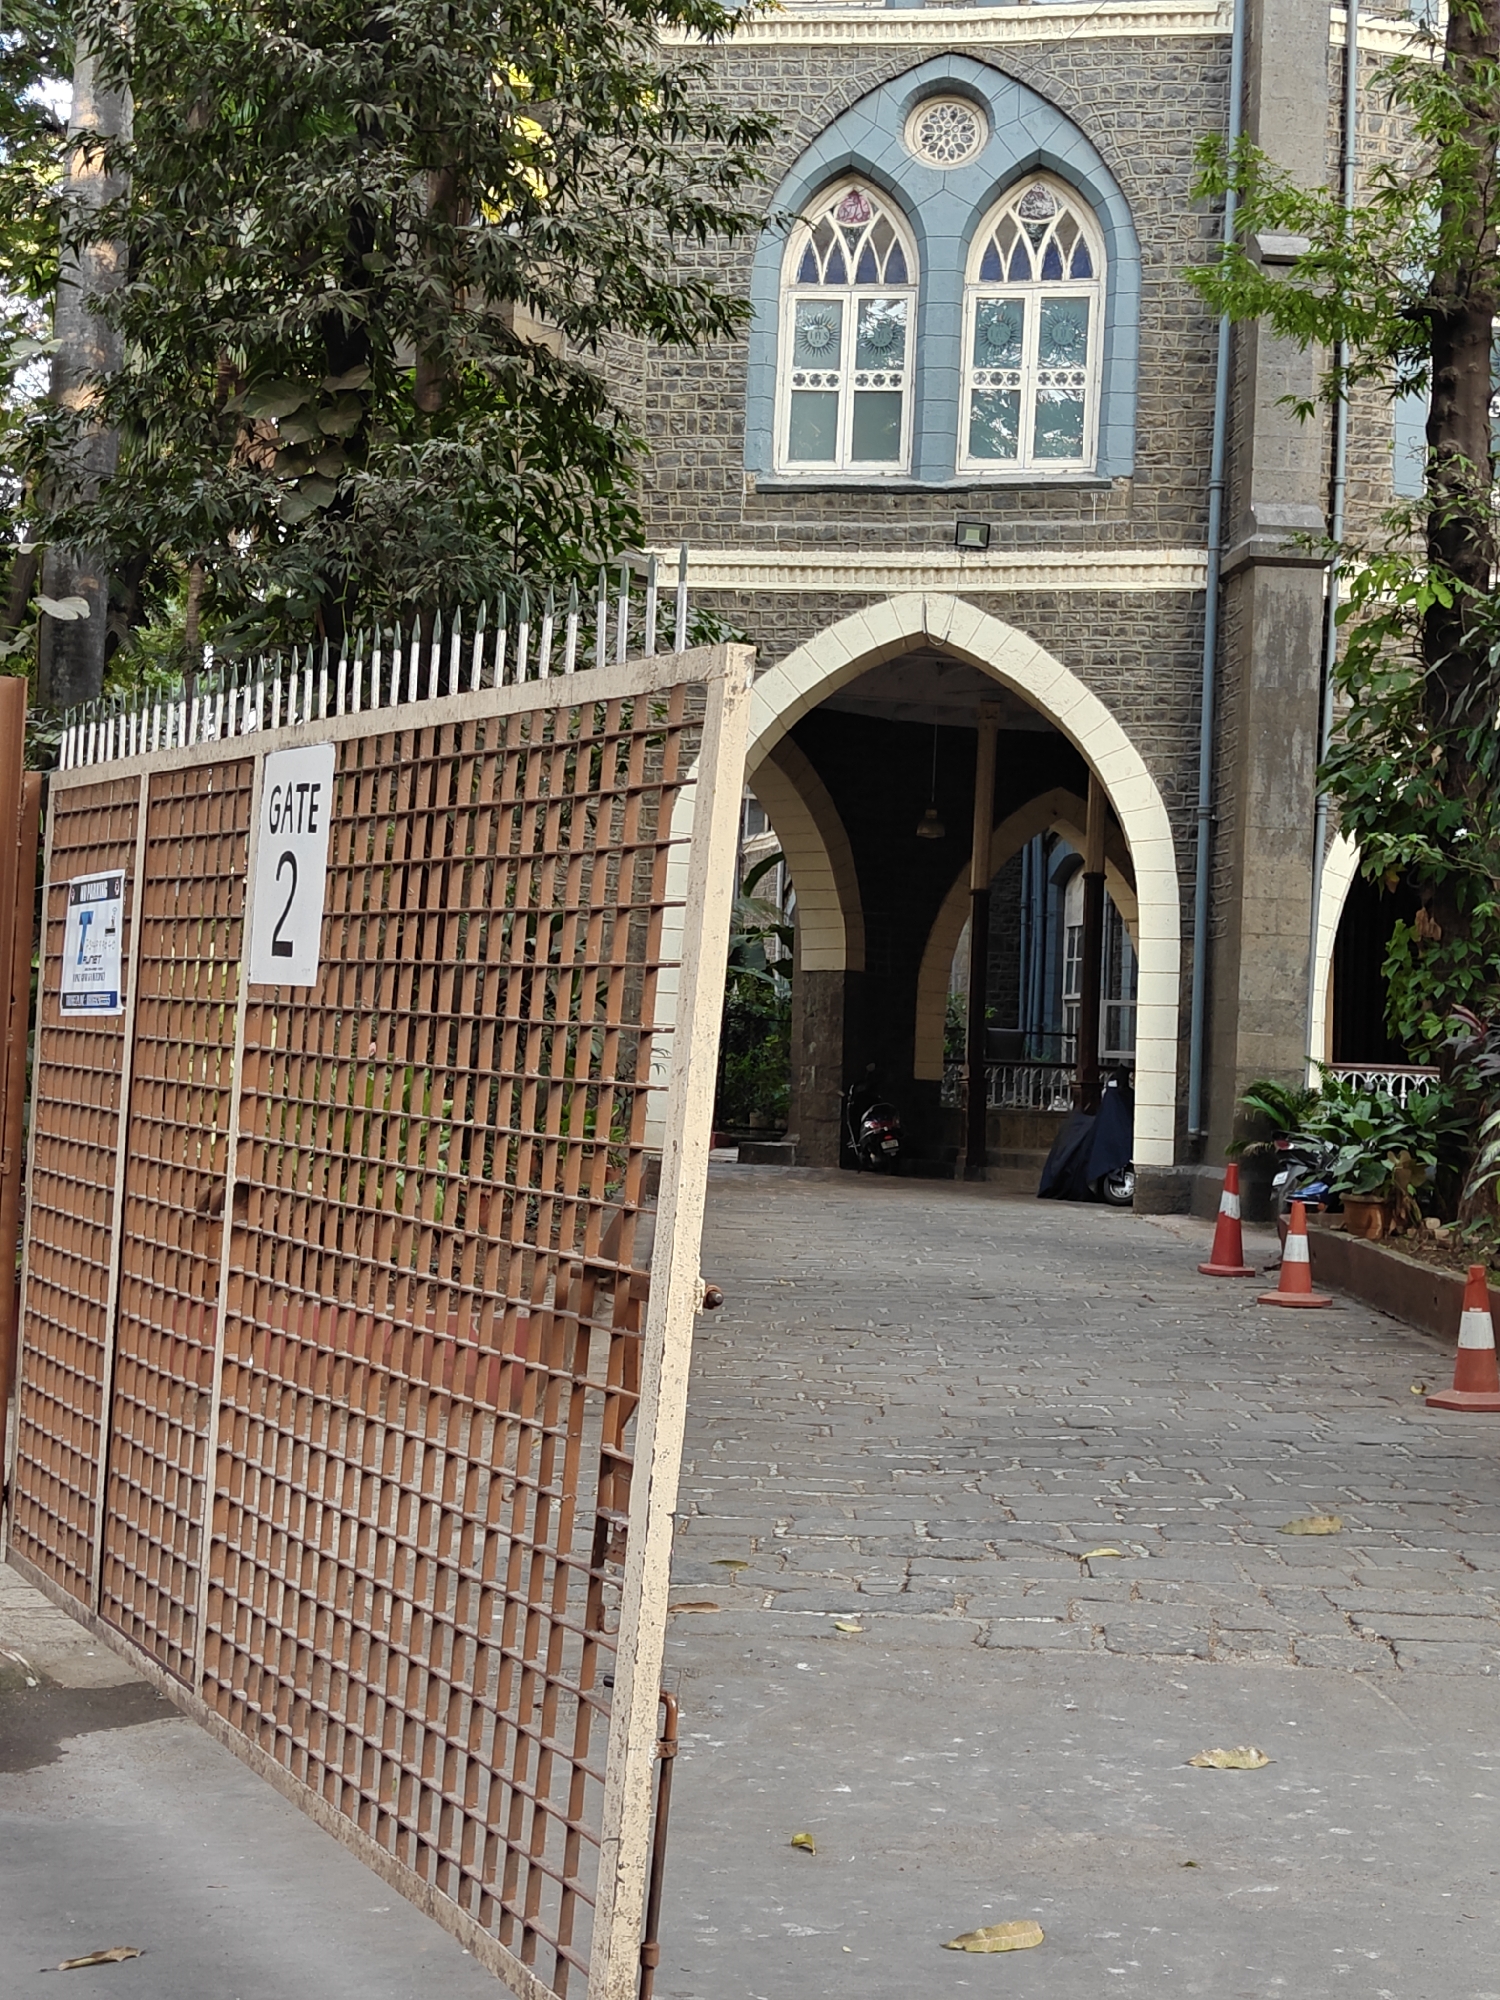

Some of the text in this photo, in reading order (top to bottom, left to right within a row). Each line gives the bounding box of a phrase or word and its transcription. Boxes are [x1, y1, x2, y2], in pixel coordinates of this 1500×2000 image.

[269, 781, 321, 834] GATE
[80, 880, 108, 902] NO PARKING
[271, 850, 298, 958] 2
